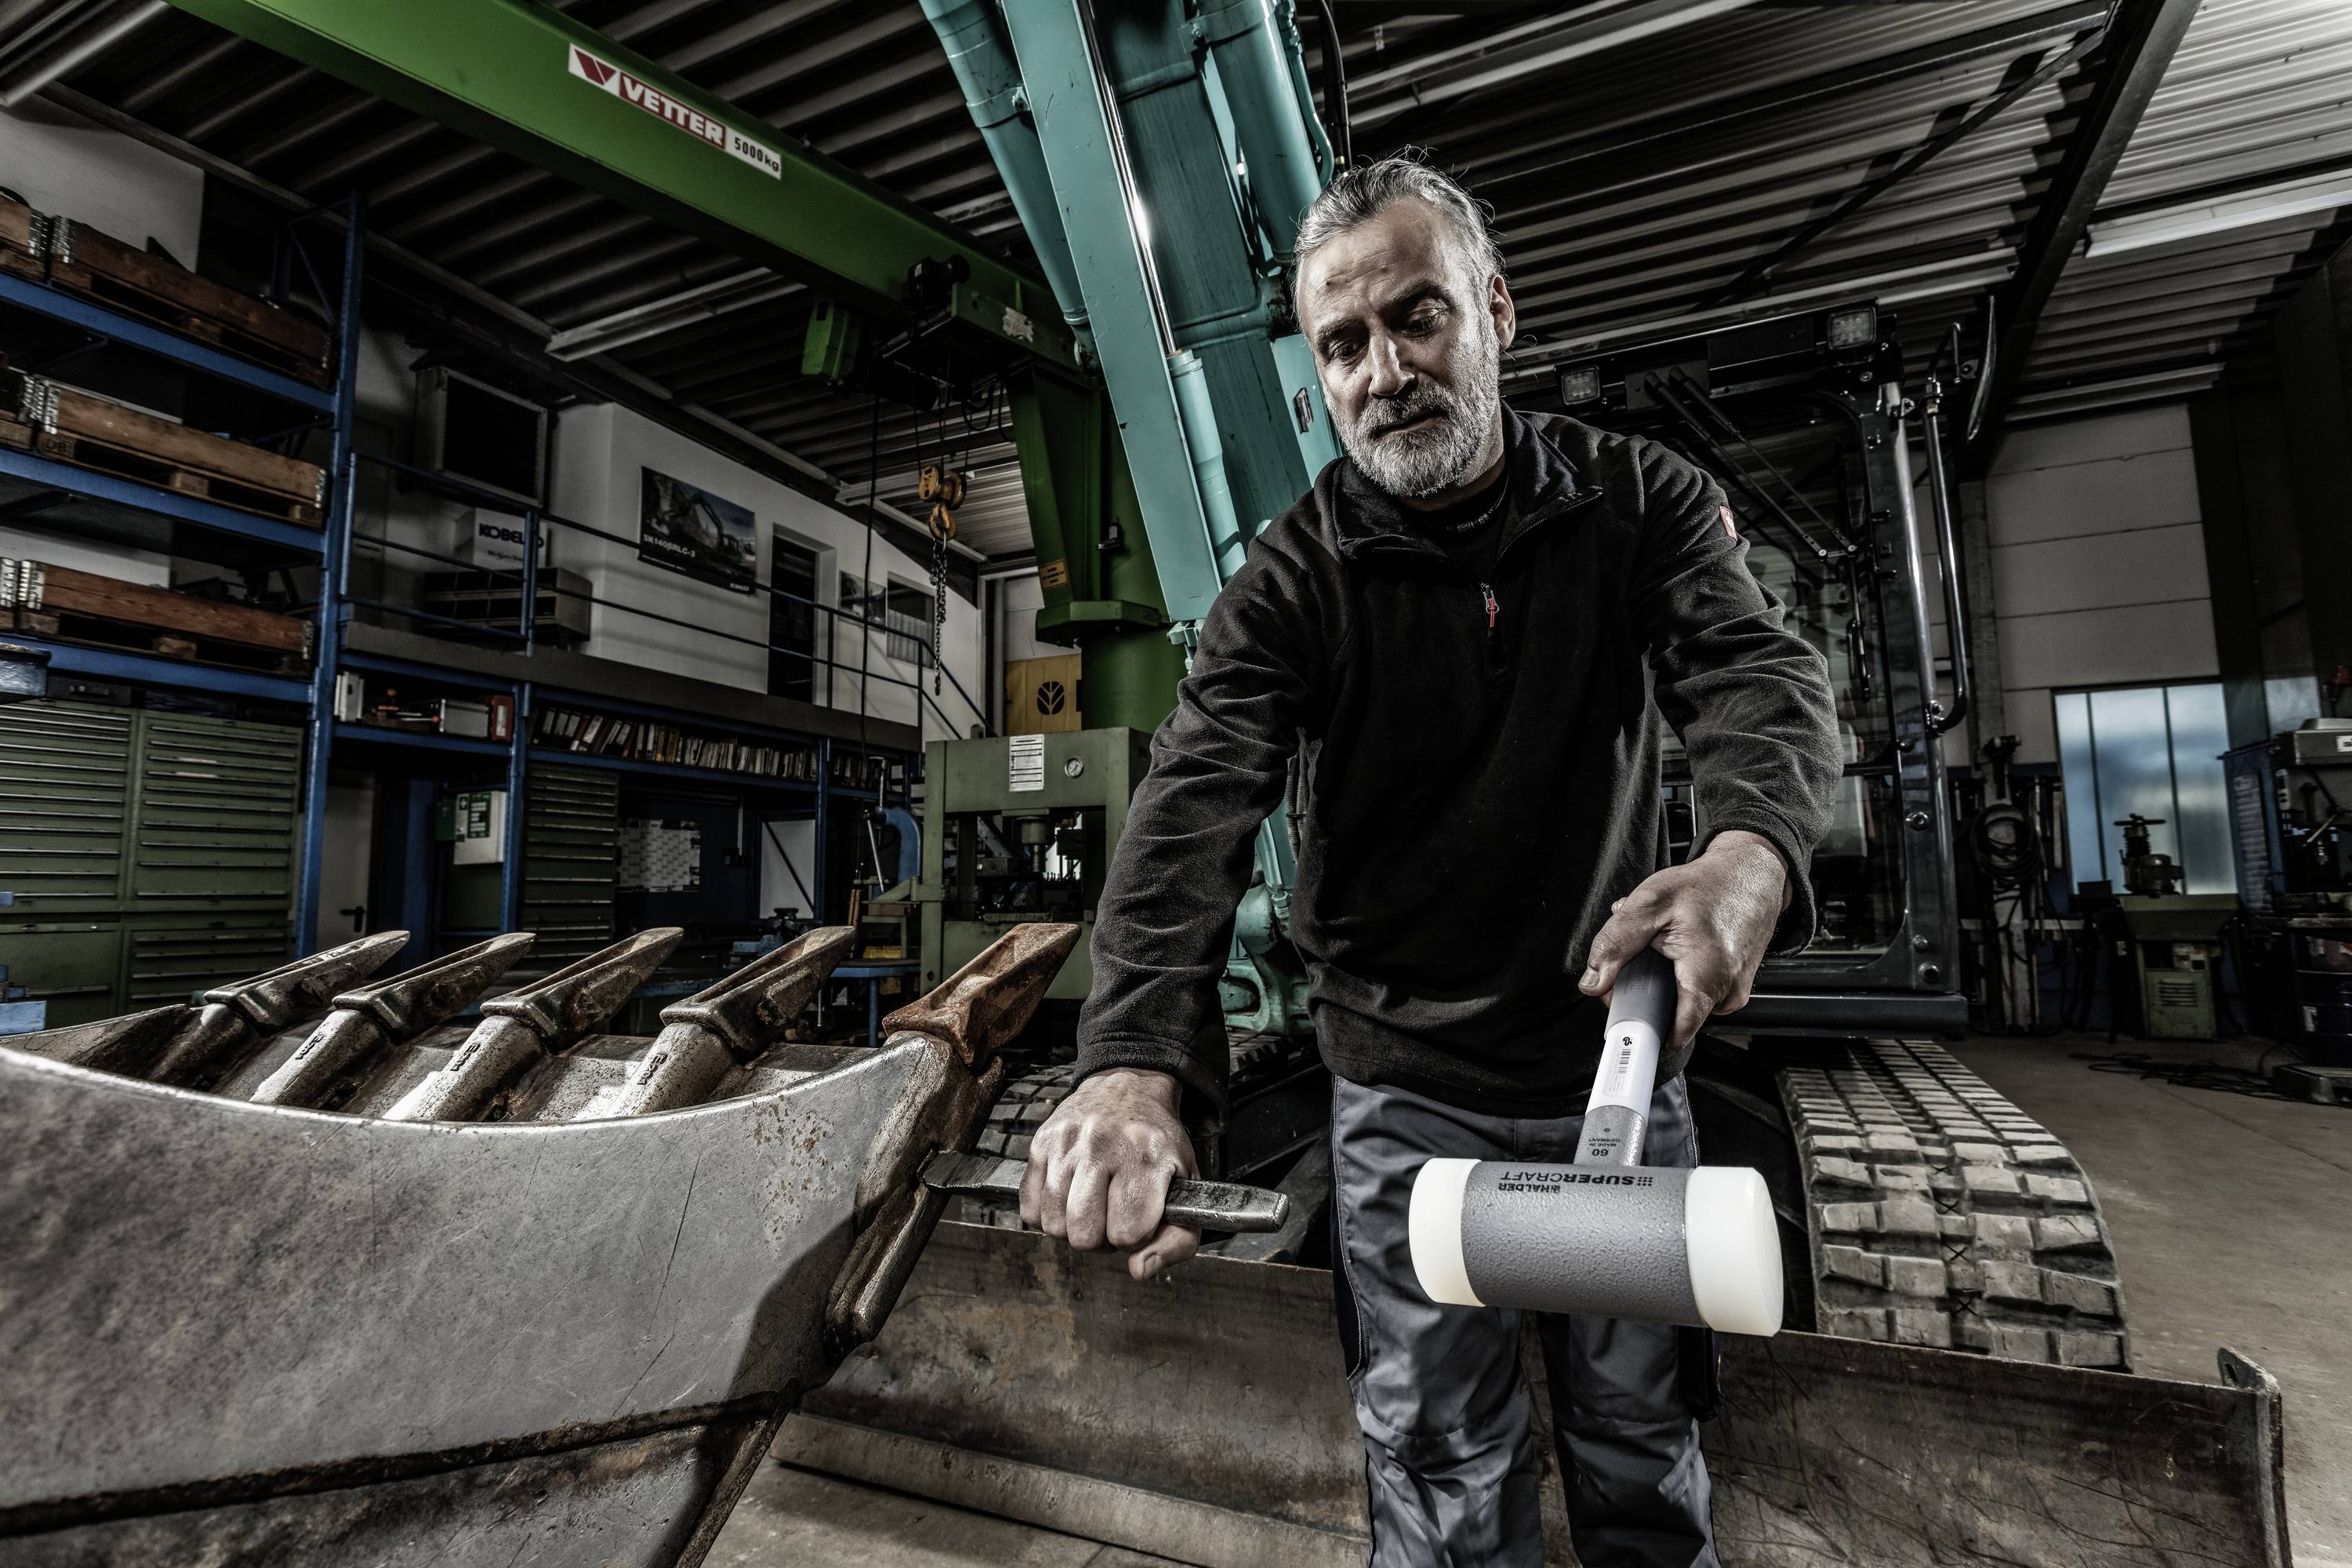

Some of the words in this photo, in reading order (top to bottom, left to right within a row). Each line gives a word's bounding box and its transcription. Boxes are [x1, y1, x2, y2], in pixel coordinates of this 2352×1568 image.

[622, 77, 724, 145] VETTER
[734, 136, 779, 172] 5000kg
[479, 523, 544, 548] KOBELO
[1498, 1182, 1550, 1193] HALDER
[1501, 1171, 1635, 1186] SUPERCRAFT
